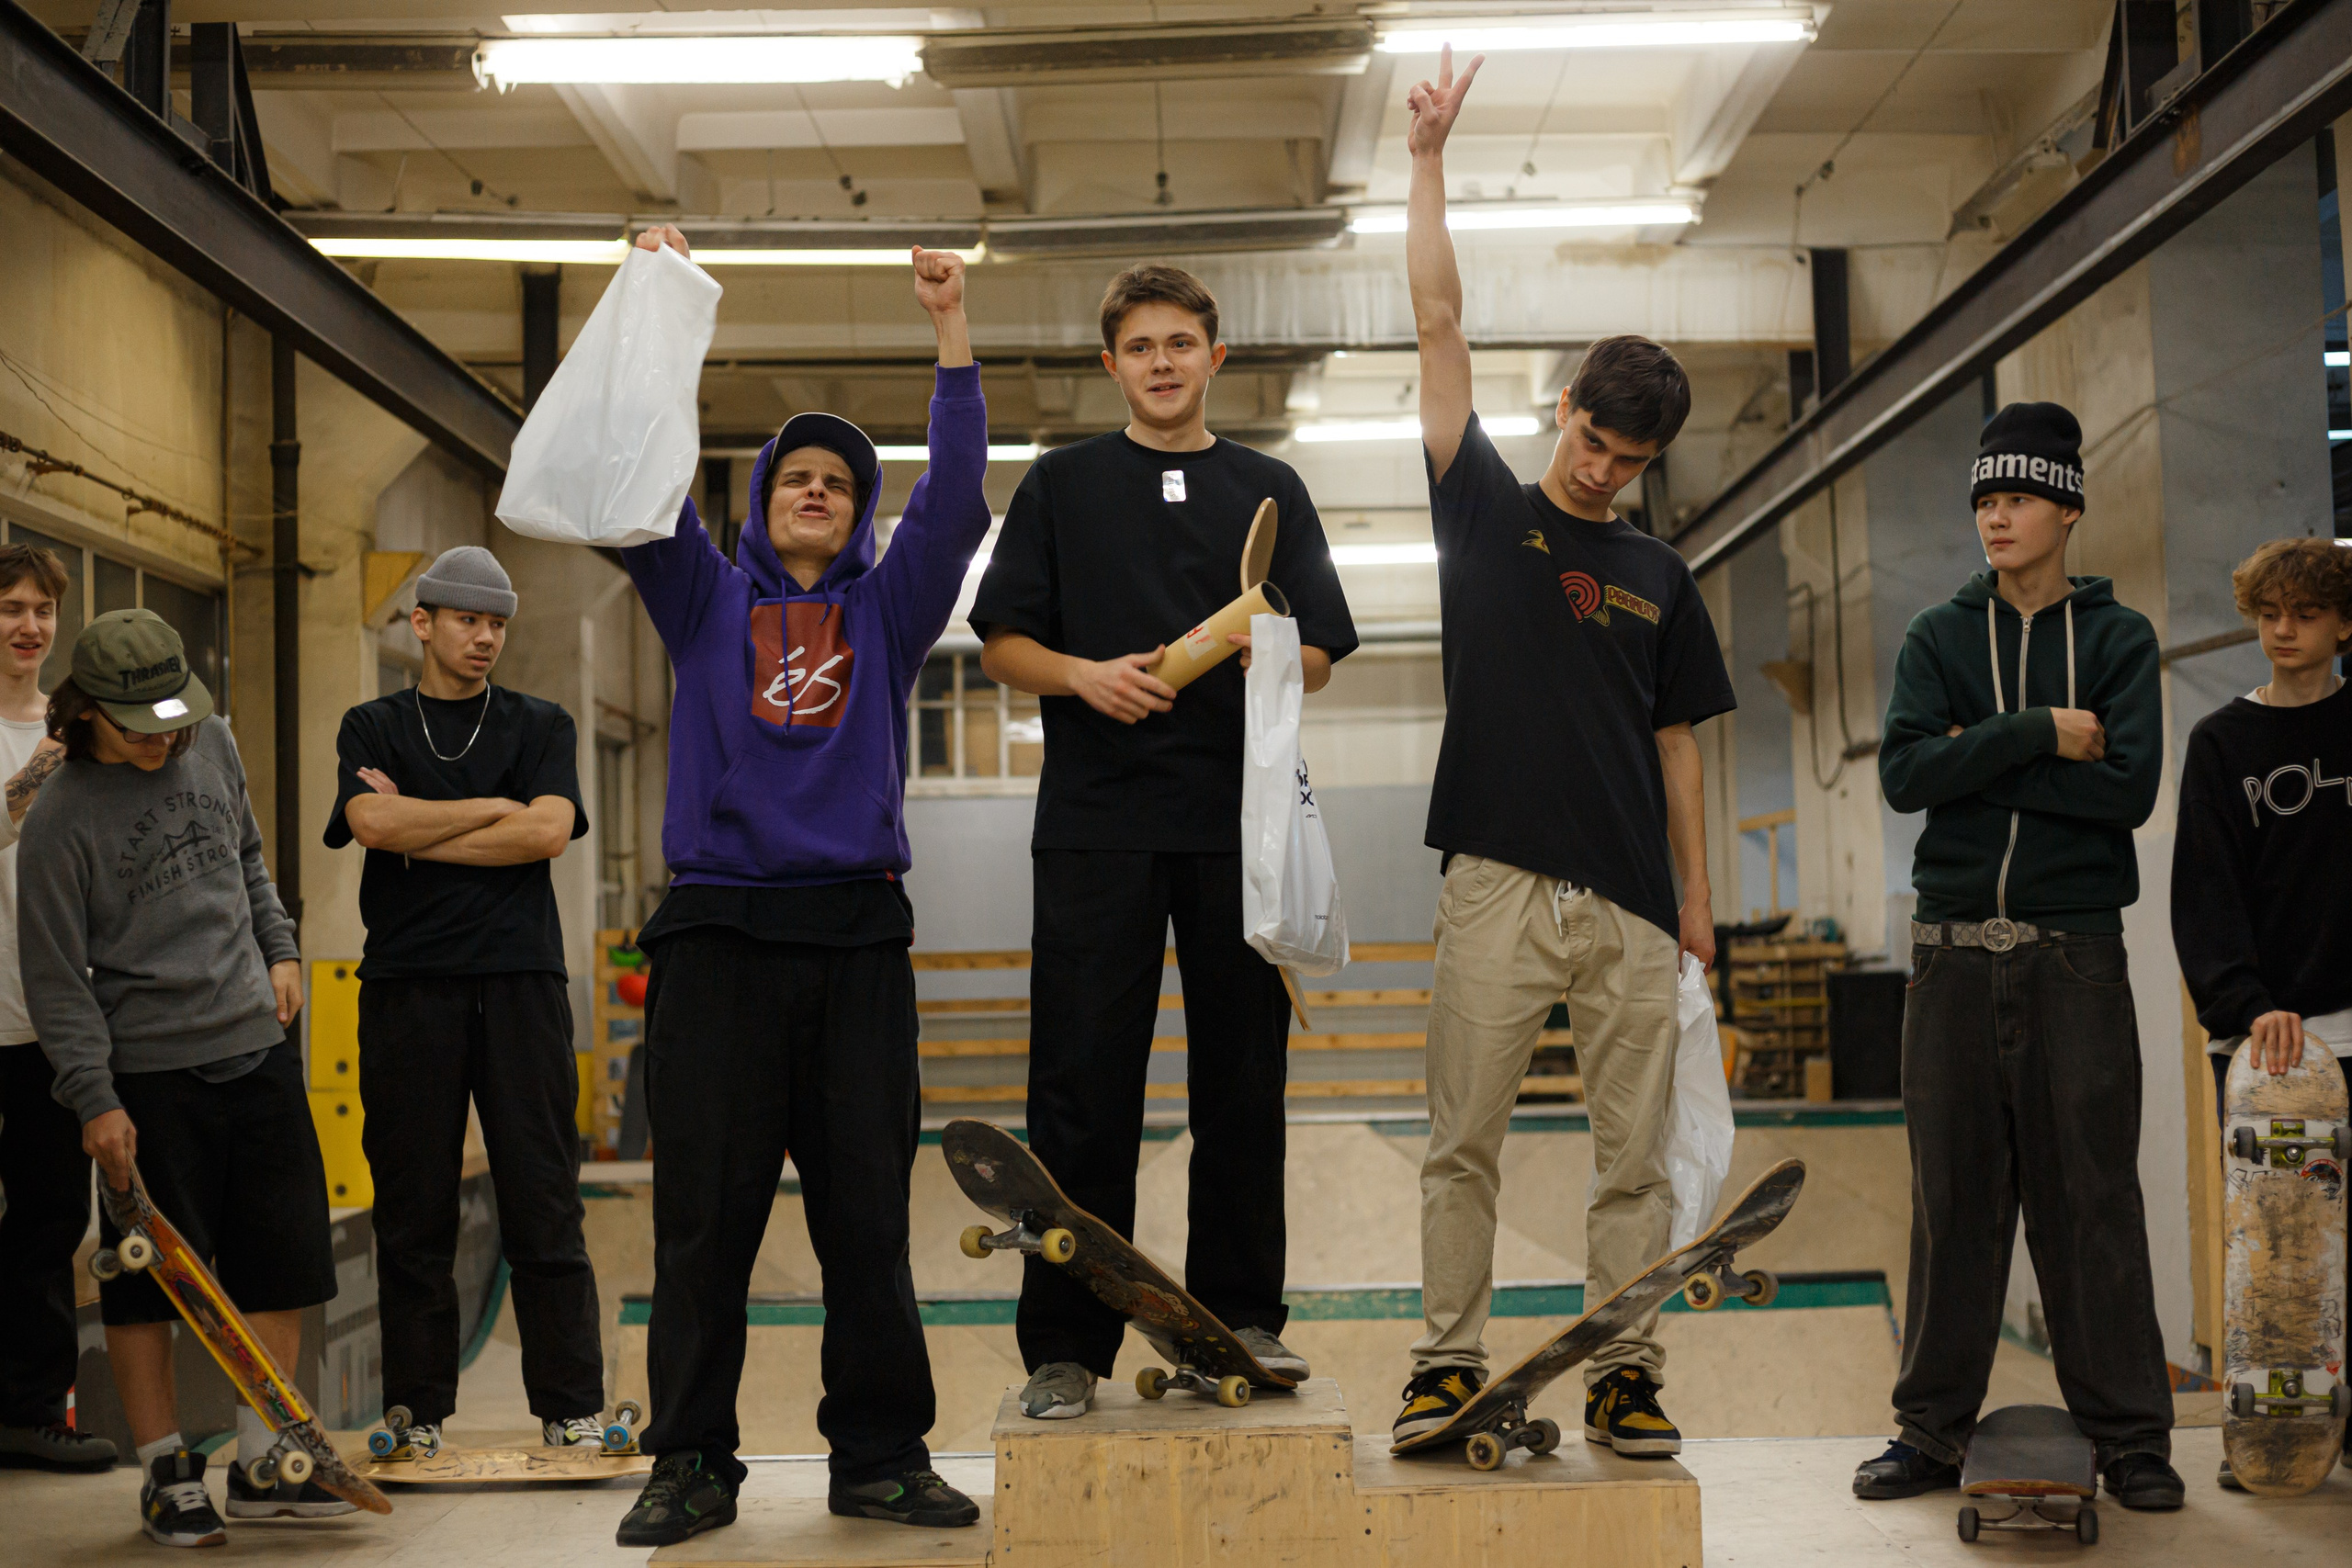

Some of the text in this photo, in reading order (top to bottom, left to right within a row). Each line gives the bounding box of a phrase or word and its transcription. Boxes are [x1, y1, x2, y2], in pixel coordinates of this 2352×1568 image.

[119, 654, 182, 690] THRASHER
[2244, 758, 2352, 827] POL
[118, 792, 232, 879] START STRONG
[128, 864, 182, 905] FINISH
[187, 836, 238, 872] STROG
